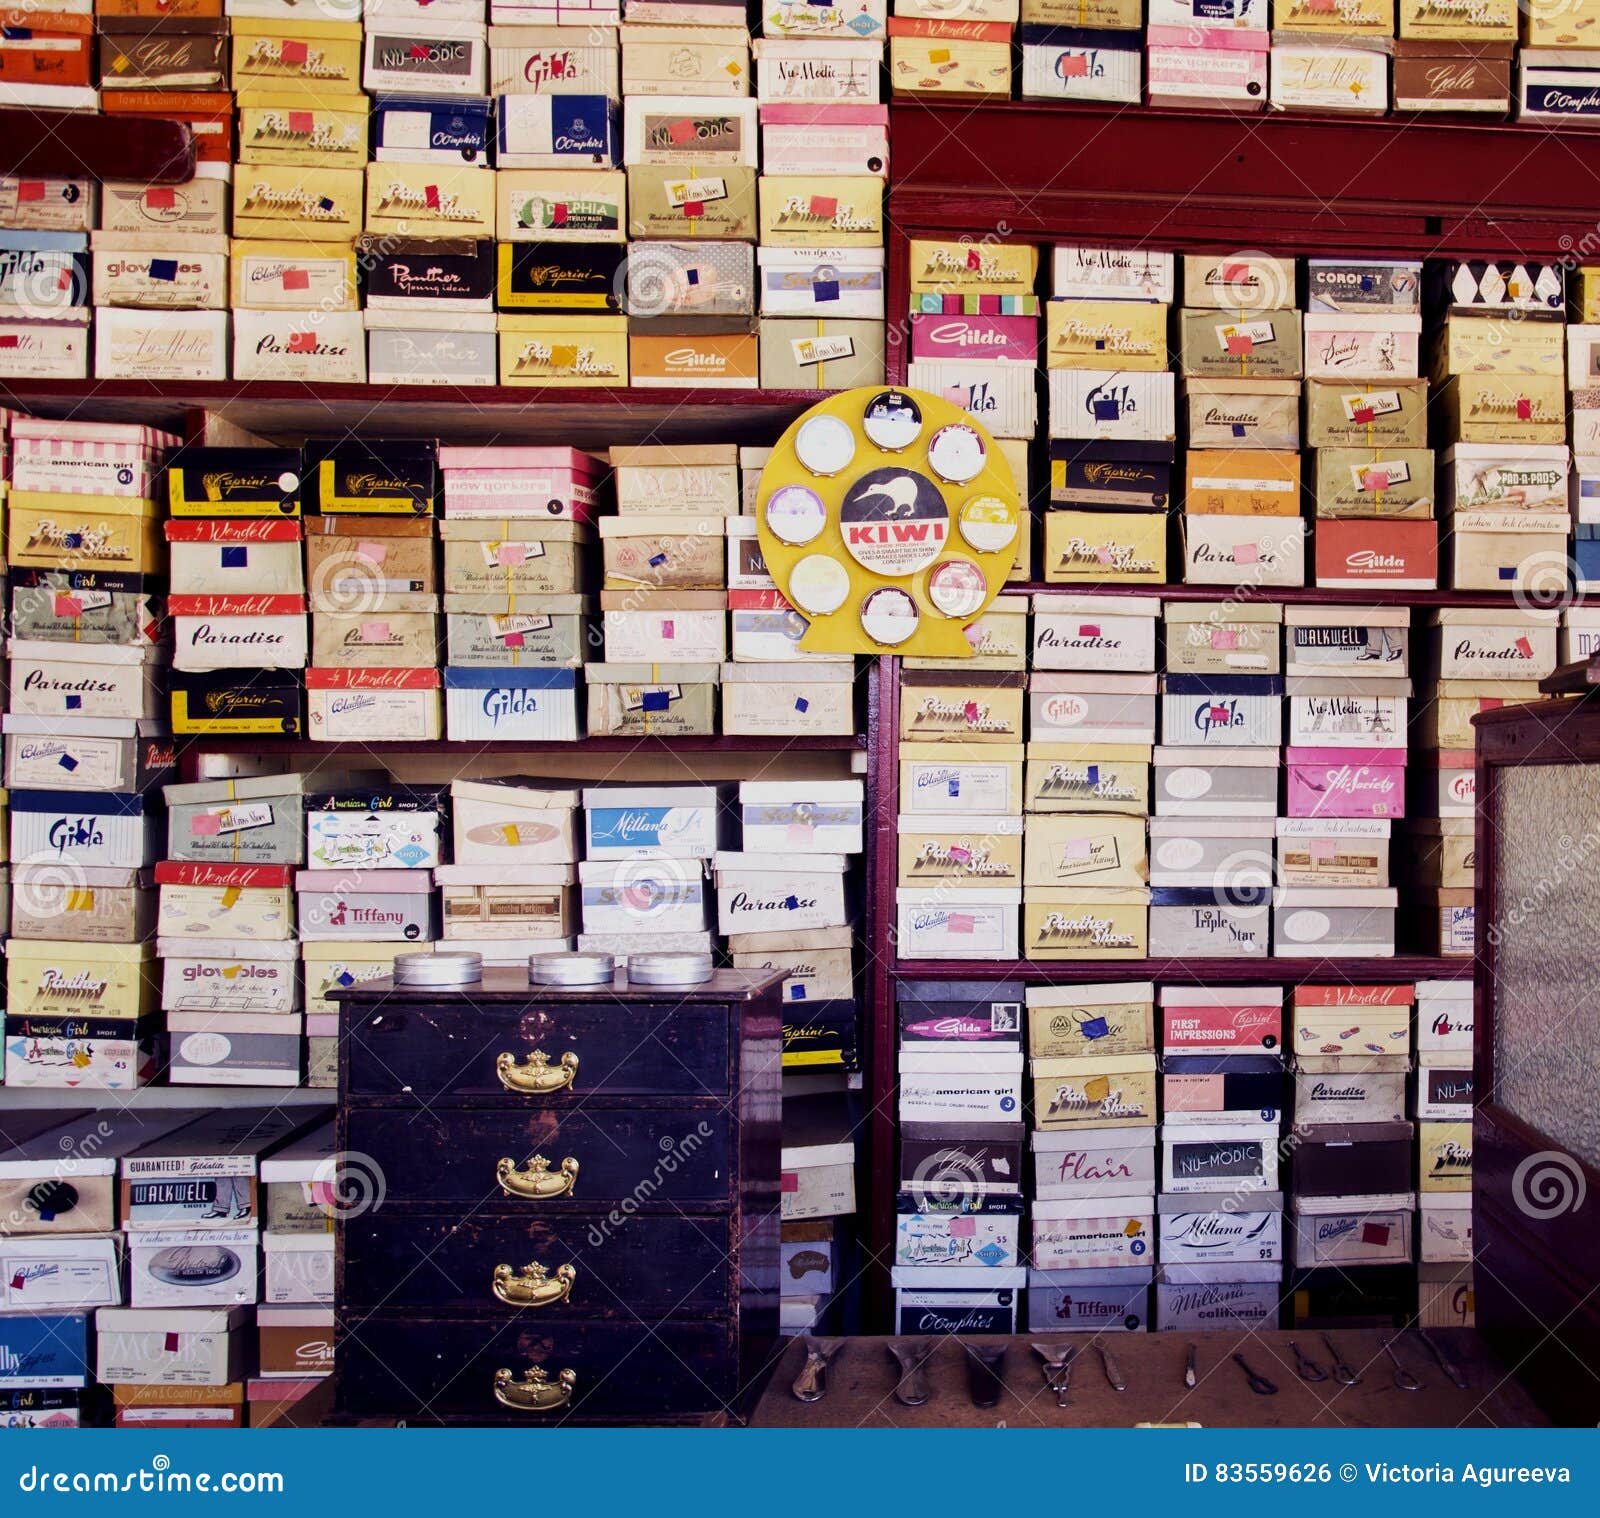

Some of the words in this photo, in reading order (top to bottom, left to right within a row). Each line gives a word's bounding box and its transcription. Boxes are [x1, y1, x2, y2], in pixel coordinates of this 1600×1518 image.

[930, 322, 1007, 346] Gilda
[665, 348, 726, 367] Gilda
[208, 520, 277, 540] Wendell
[849, 523, 944, 545] KIWI
[1346, 550, 1405, 568] Gilda
[208, 597, 277, 615] Wendell
[192, 624, 285, 646] Paradise
[1038, 629, 1122, 649] Paradise
[1298, 629, 1361, 646] WALKWELL
[24, 669, 117, 692] Paradise
[345, 669, 410, 688] Wendell
[483, 688, 538, 728] Gilda
[192, 866, 259, 886] Wendell
[352, 907, 404, 925] Tiffany
[1042, 911, 1112, 930] Panther
[1192, 910, 1228, 933] Triple
[1090, 928, 1134, 943] Shoes
[1228, 921, 1256, 942] Star
[934, 1018, 981, 1034] Gilda
[1171, 1019, 1200, 1030] FIRST
[1170, 1030, 1236, 1041] IMPRESSIONS
[935, 1088, 991, 1096] american
[994, 1087, 1014, 1097] girl
[1311, 1082, 1366, 1097] Paradise
[1100, 1099, 1144, 1115] Shoes
[130, 1159, 185, 1173] GUARANTEED!
[1057, 1151, 1133, 1184] Flair
[1181, 1145, 1257, 1176] NU-MODIC
[133, 1182, 210, 1204] WALKWELL
[1069, 1233, 1123, 1241] american
[1259, 1249, 1273, 1259] 95
[1075, 1301, 1127, 1319] Tiffany
[1198, 1305, 1268, 1320] california
